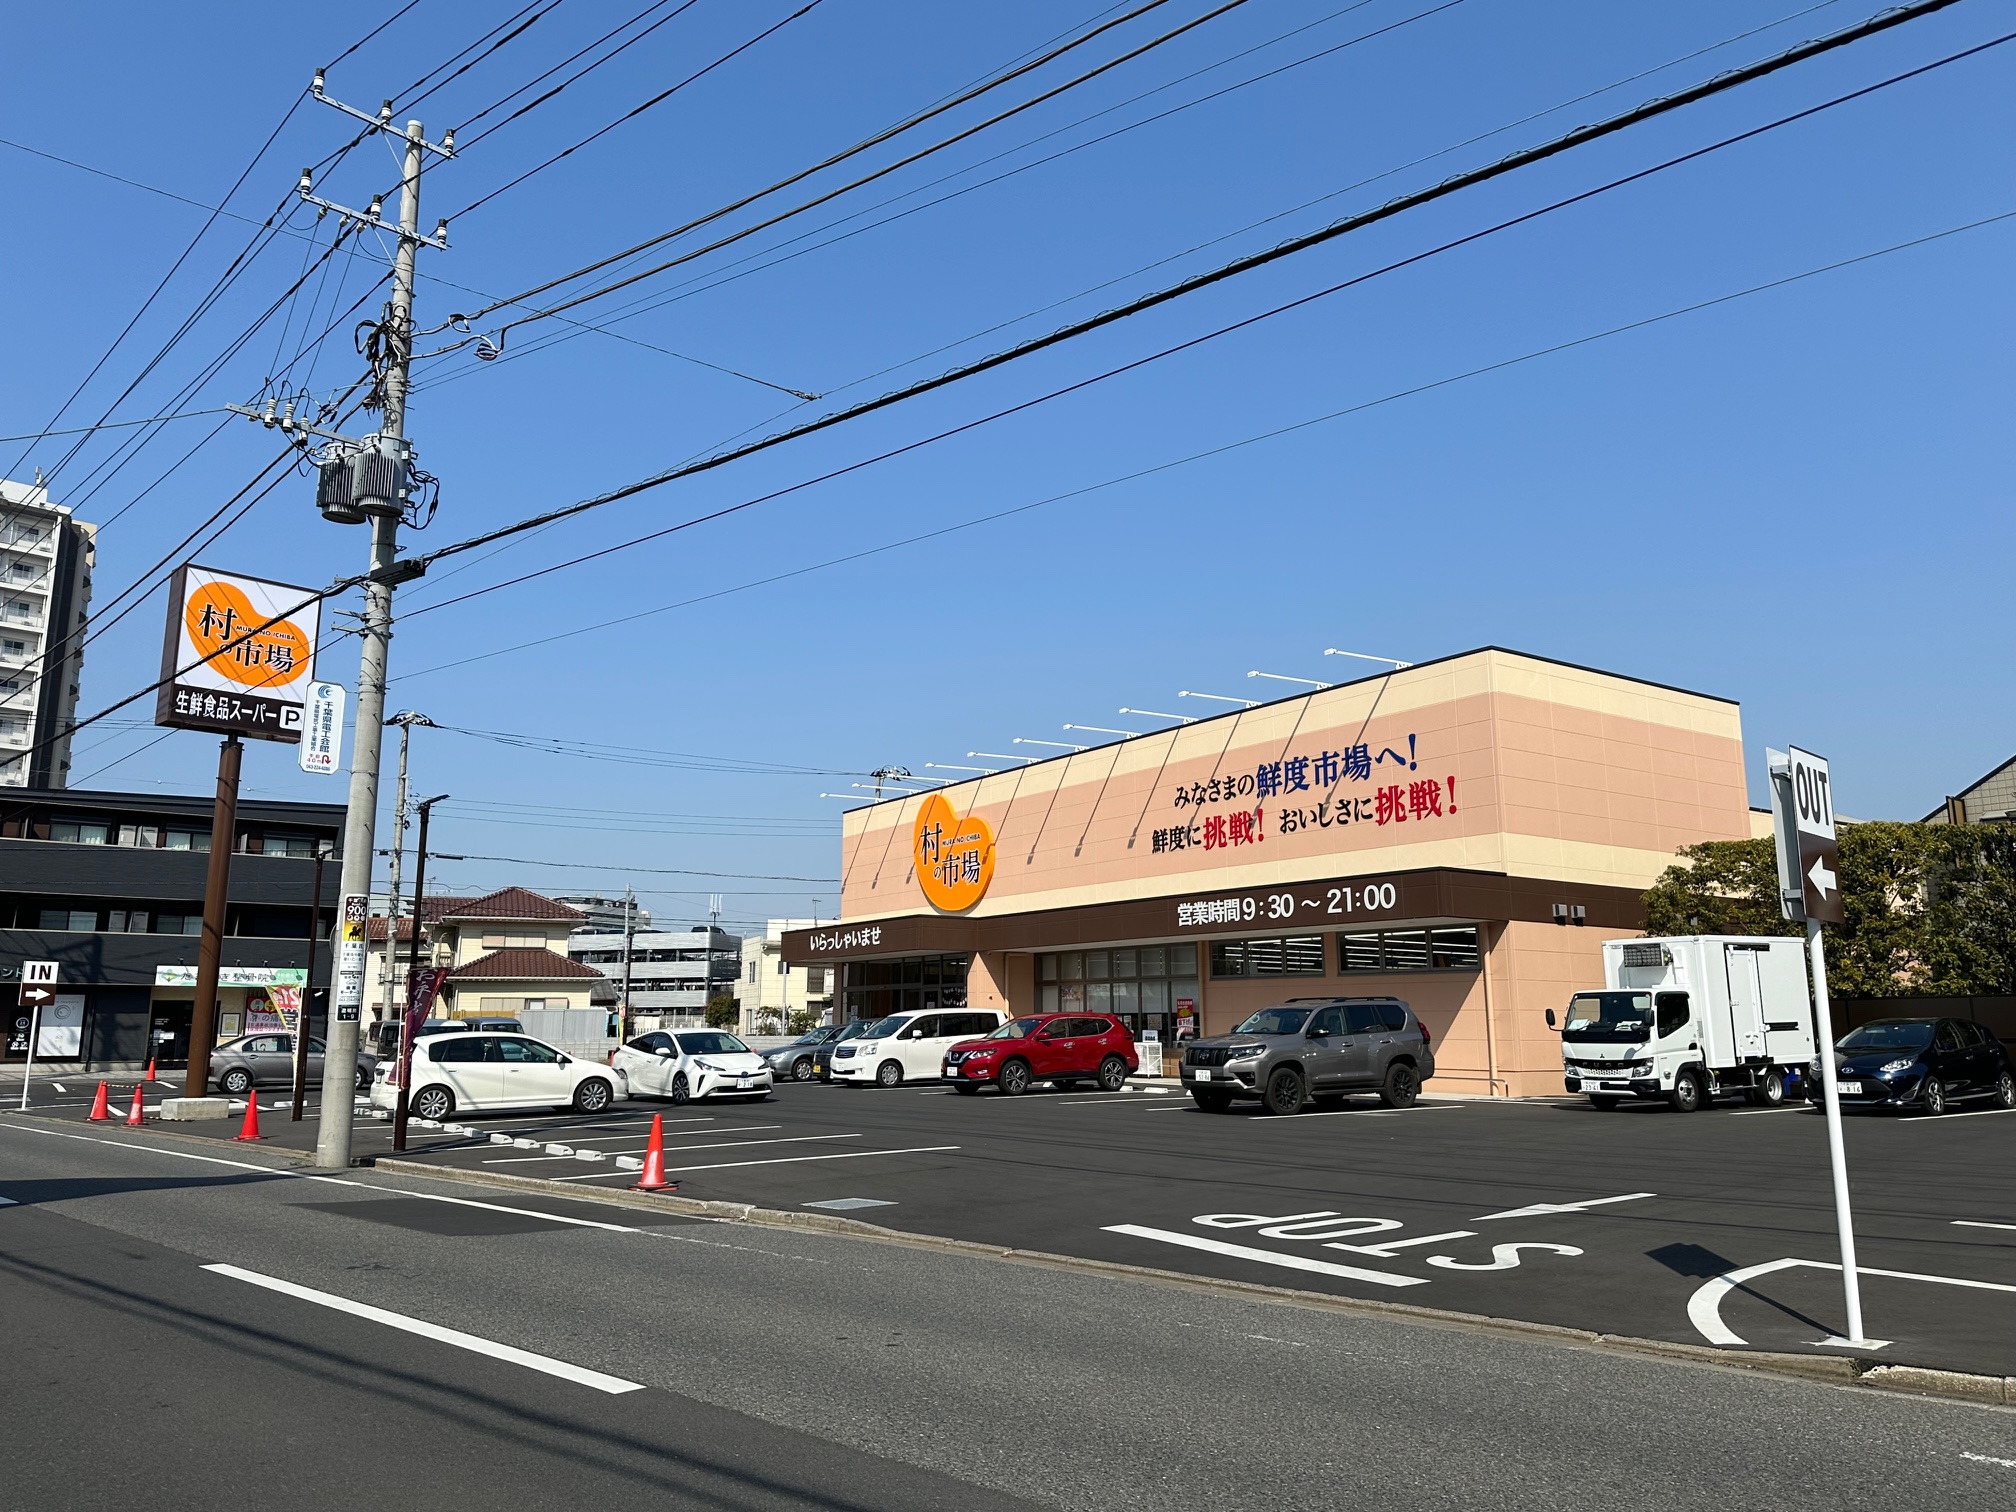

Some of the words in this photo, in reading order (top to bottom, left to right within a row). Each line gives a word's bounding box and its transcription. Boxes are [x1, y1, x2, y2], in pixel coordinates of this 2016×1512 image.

[195, 603, 238, 640] 村
[273, 633, 296, 641] ICHIBA
[175, 689, 276, 723] 生鮮食品スーパー
[319, 701, 335, 753] 千葉県電工会館
[1795, 761, 1830, 826] OUT
[1151, 808, 1264, 854] 鮮度に挑戦！
[1279, 775, 1458, 834] おいしさに挑戦！
[920, 822, 942, 865] 村
[932, 849, 981, 887] の市場
[810, 926, 882, 951] いらっしゃいませ
[30, 964, 52, 980] IN
[1191, 1209, 1584, 1272] STOP
